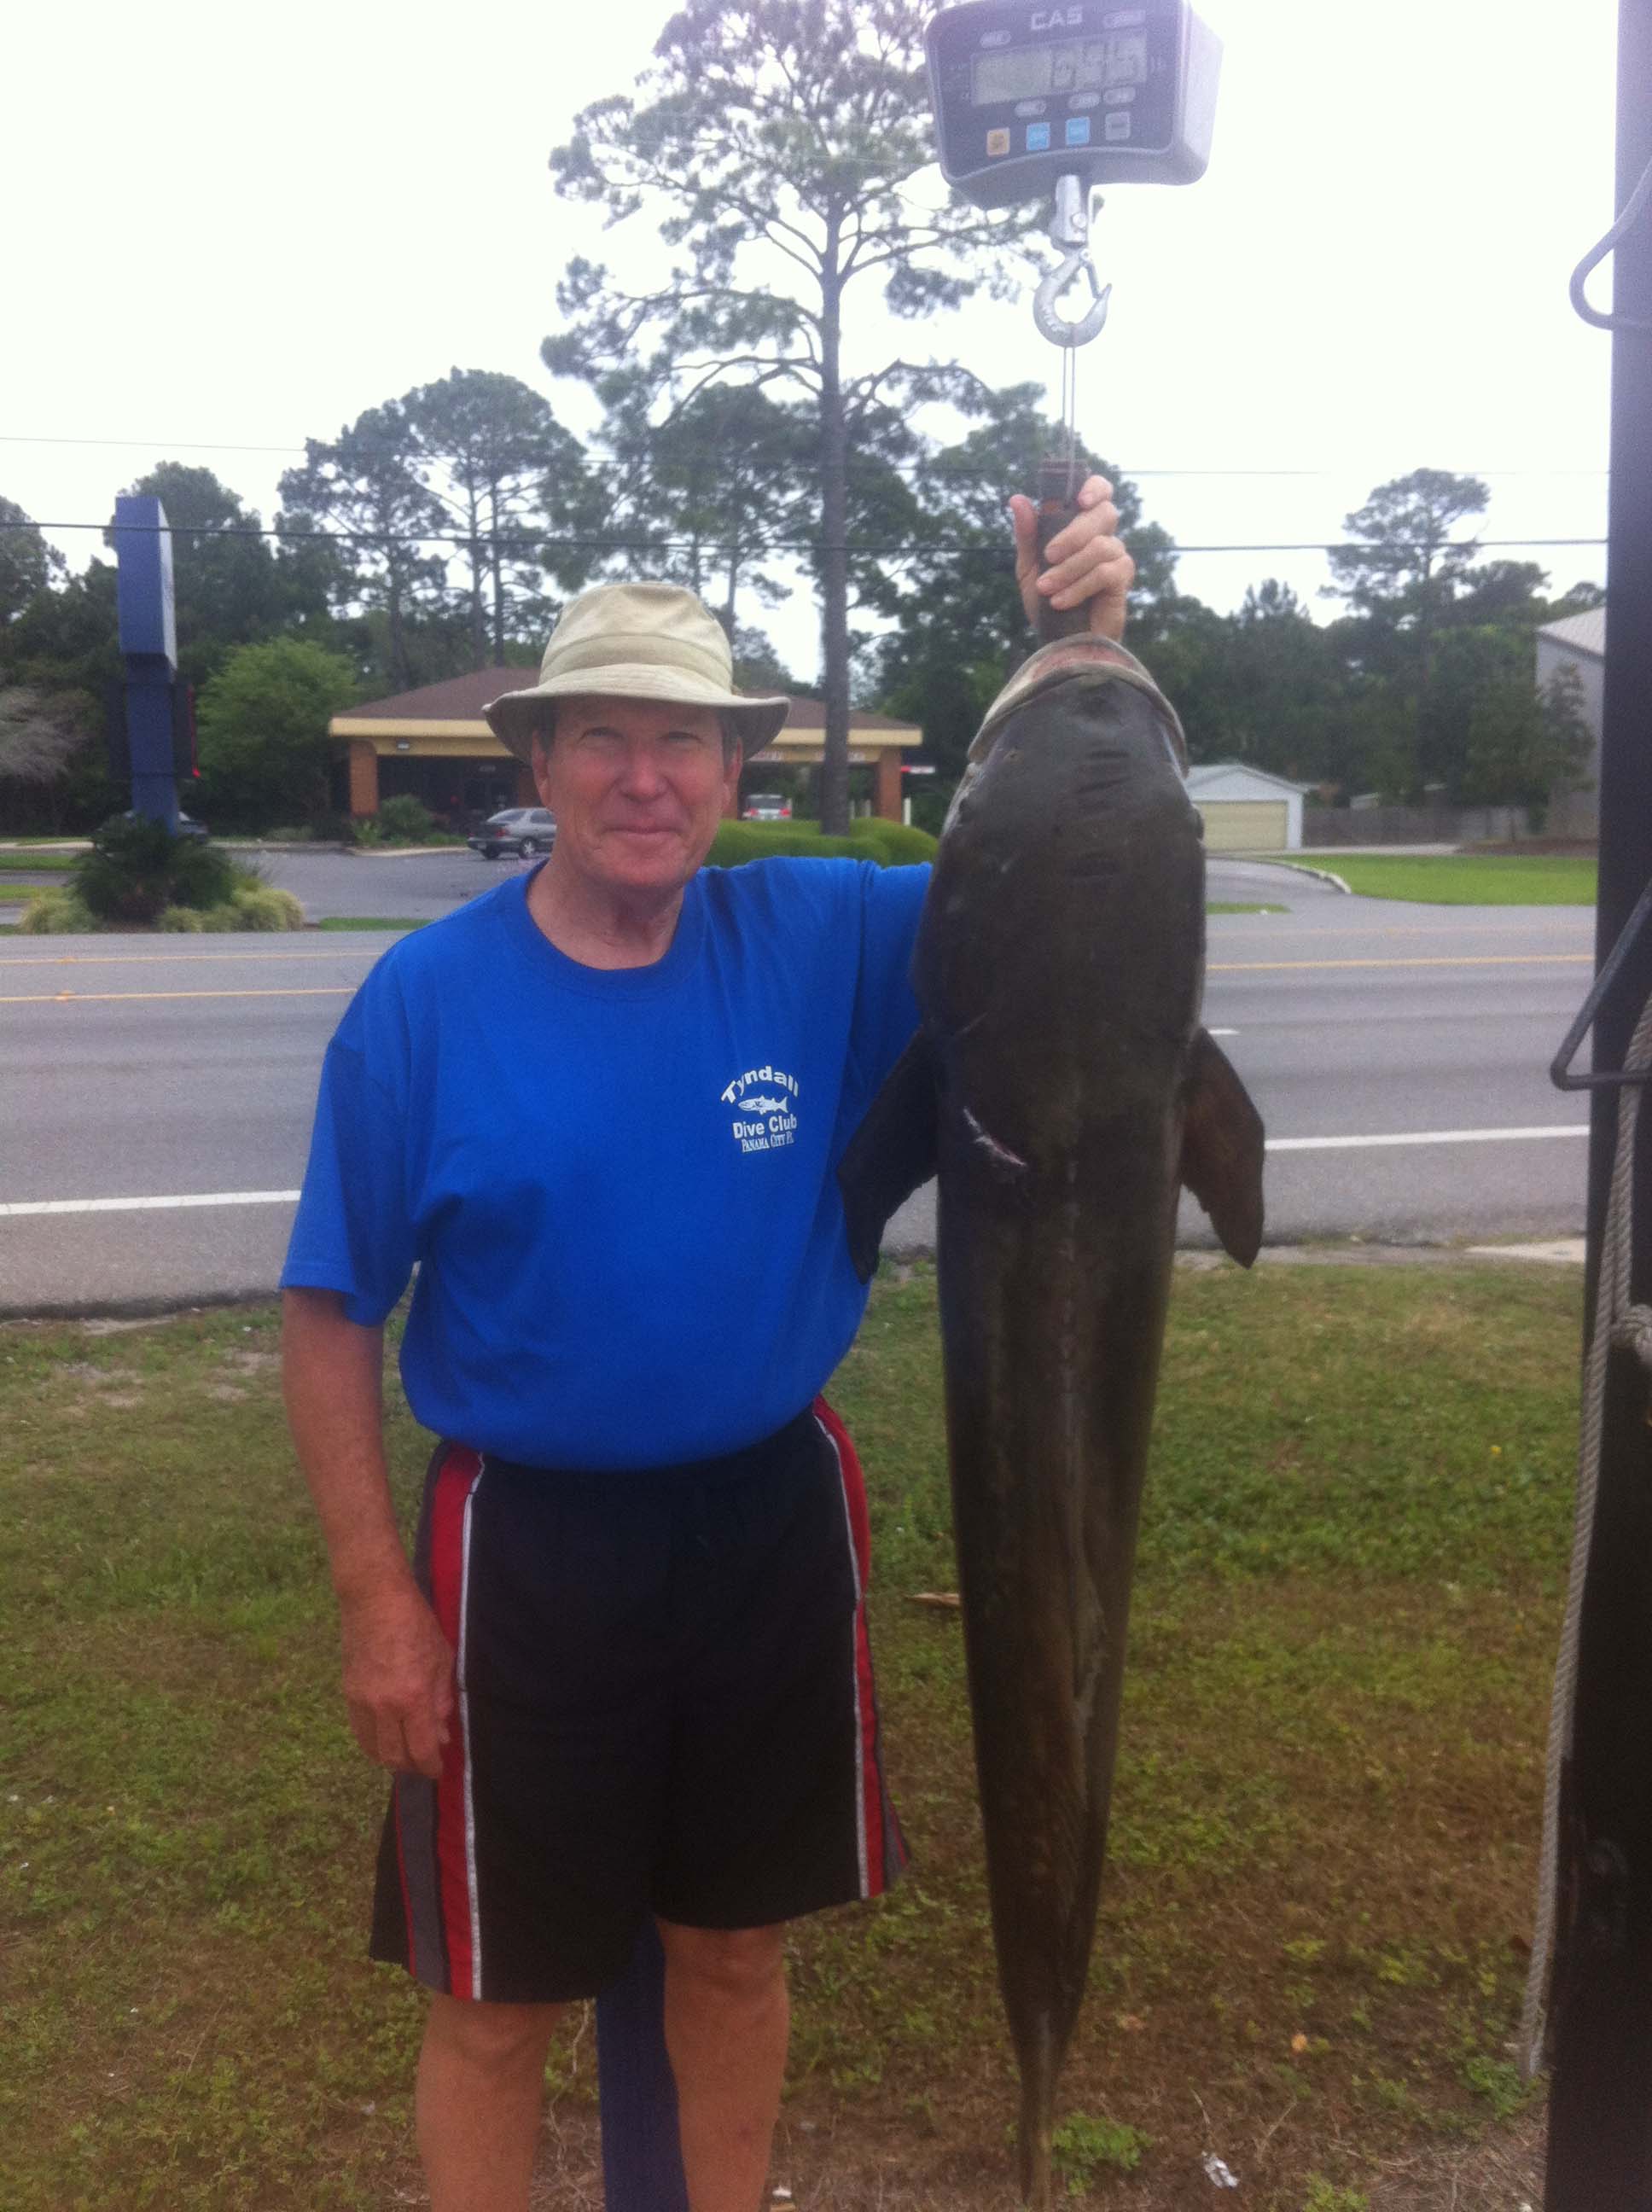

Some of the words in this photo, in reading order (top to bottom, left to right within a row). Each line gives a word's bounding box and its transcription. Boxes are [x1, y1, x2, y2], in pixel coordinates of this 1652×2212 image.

[721, 1065, 799, 1103] Tyndall
[732, 1121, 765, 1139] Dive
[769, 1113, 797, 1132] Club
